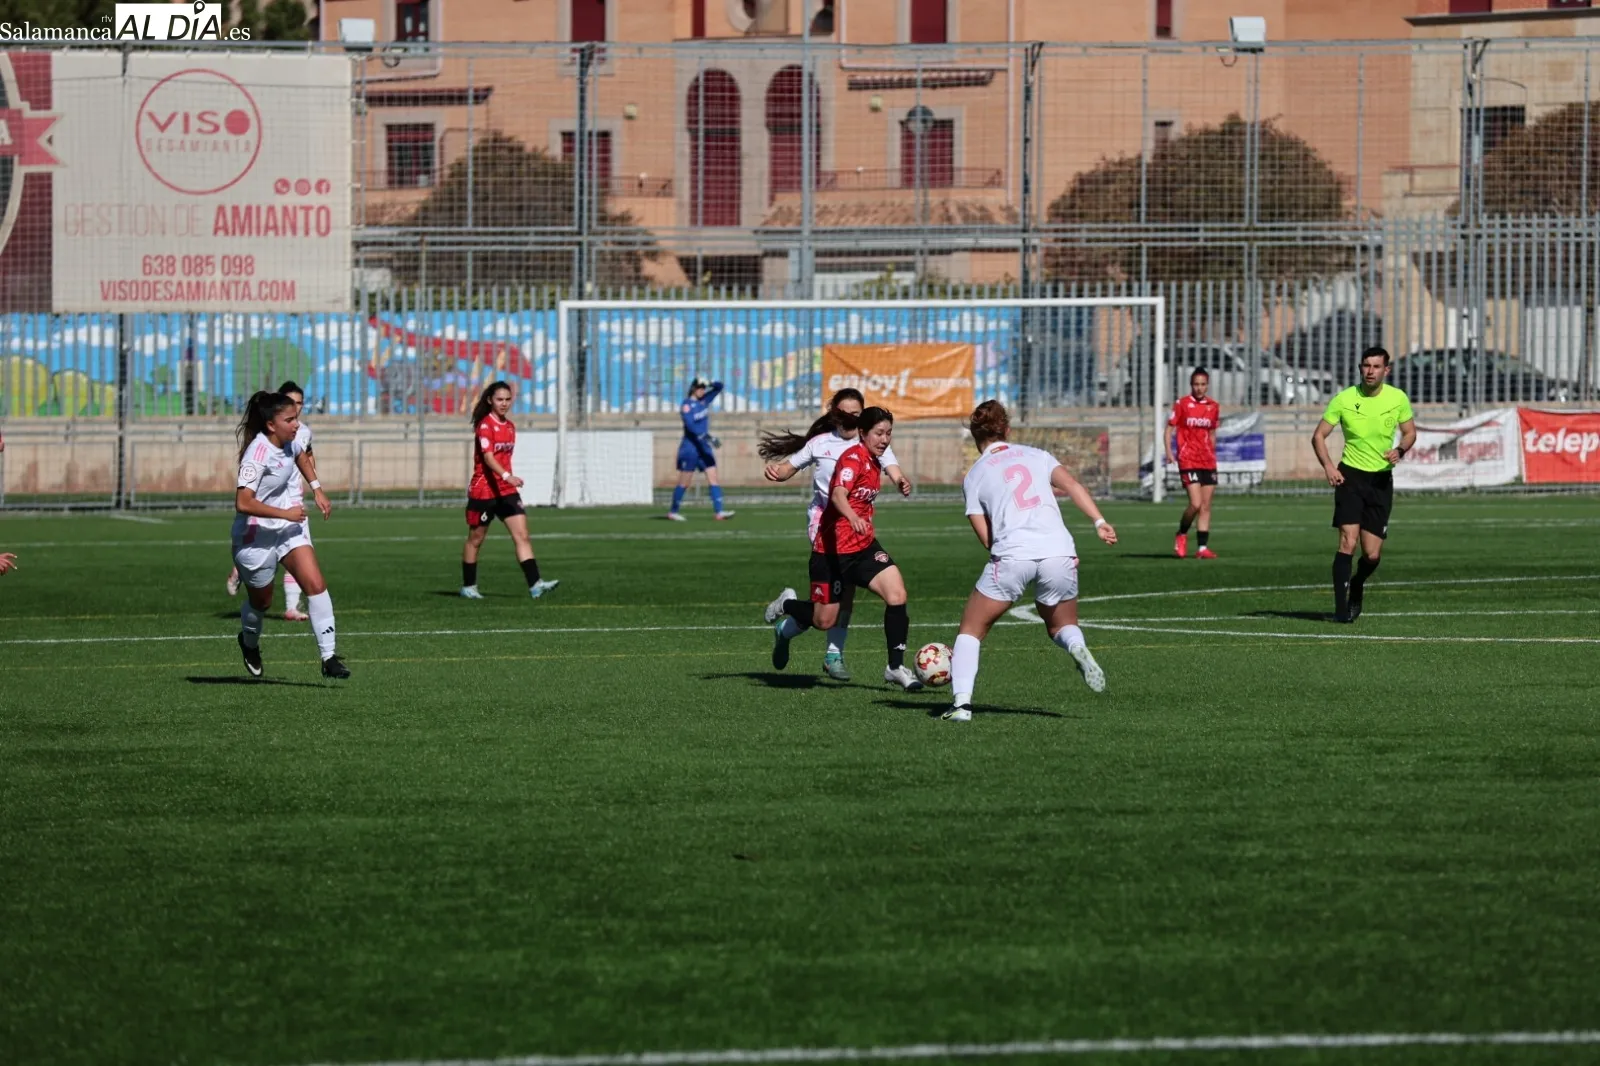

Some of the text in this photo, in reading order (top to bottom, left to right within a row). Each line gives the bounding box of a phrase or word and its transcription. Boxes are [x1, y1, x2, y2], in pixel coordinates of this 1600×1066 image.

[174, 204, 203, 236] DE
[213, 204, 331, 237] AMIANTO
[142, 254, 255, 276] 638 085 098
[100, 280, 296, 301] VISODESAMIANTA.COM
[1524, 427, 1600, 464] telep
[1004, 463, 1041, 511] 2
[480, 511, 488, 522] 6
[833, 580, 841, 595] 8
